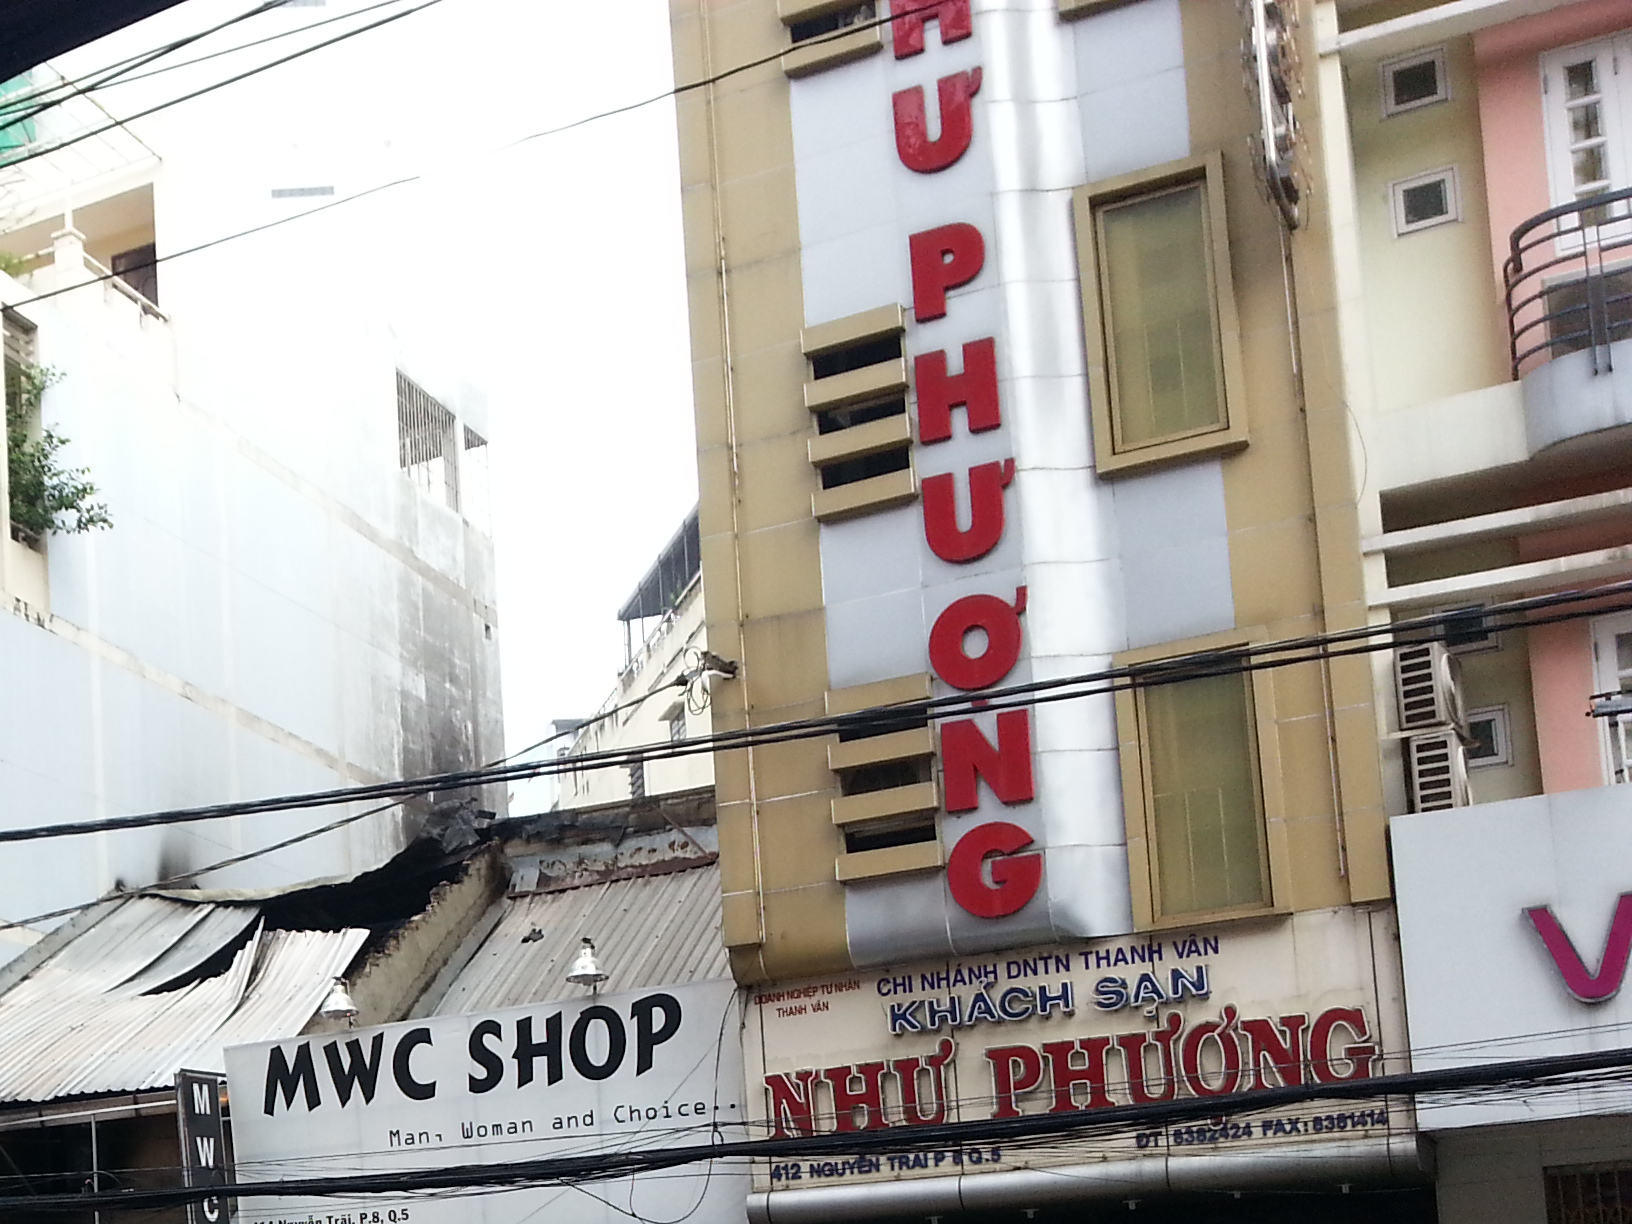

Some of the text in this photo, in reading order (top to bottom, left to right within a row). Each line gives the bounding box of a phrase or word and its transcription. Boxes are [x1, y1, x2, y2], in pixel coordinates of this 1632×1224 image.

[877, 934, 1219, 996] CHI NHÁNH DNTN THANH VÂN
[754, 992, 785, 1005] DOANH
[835, 979, 860, 992] NHÂN
[776, 1000, 830, 1018] THANH VÂN
[888, 964, 1211, 1034] KHÁCH SẠN
[264, 993, 682, 1117] MWC SHOP
[764, 1036, 955, 1140] NHƯ
[389, 1128, 443, 1148] Man,
[461, 1118, 534, 1140] Woman
[552, 1110, 595, 1131] and
[771, 1163, 801, 1181] 412
[388, 1208, 410, 1223] Q.5
